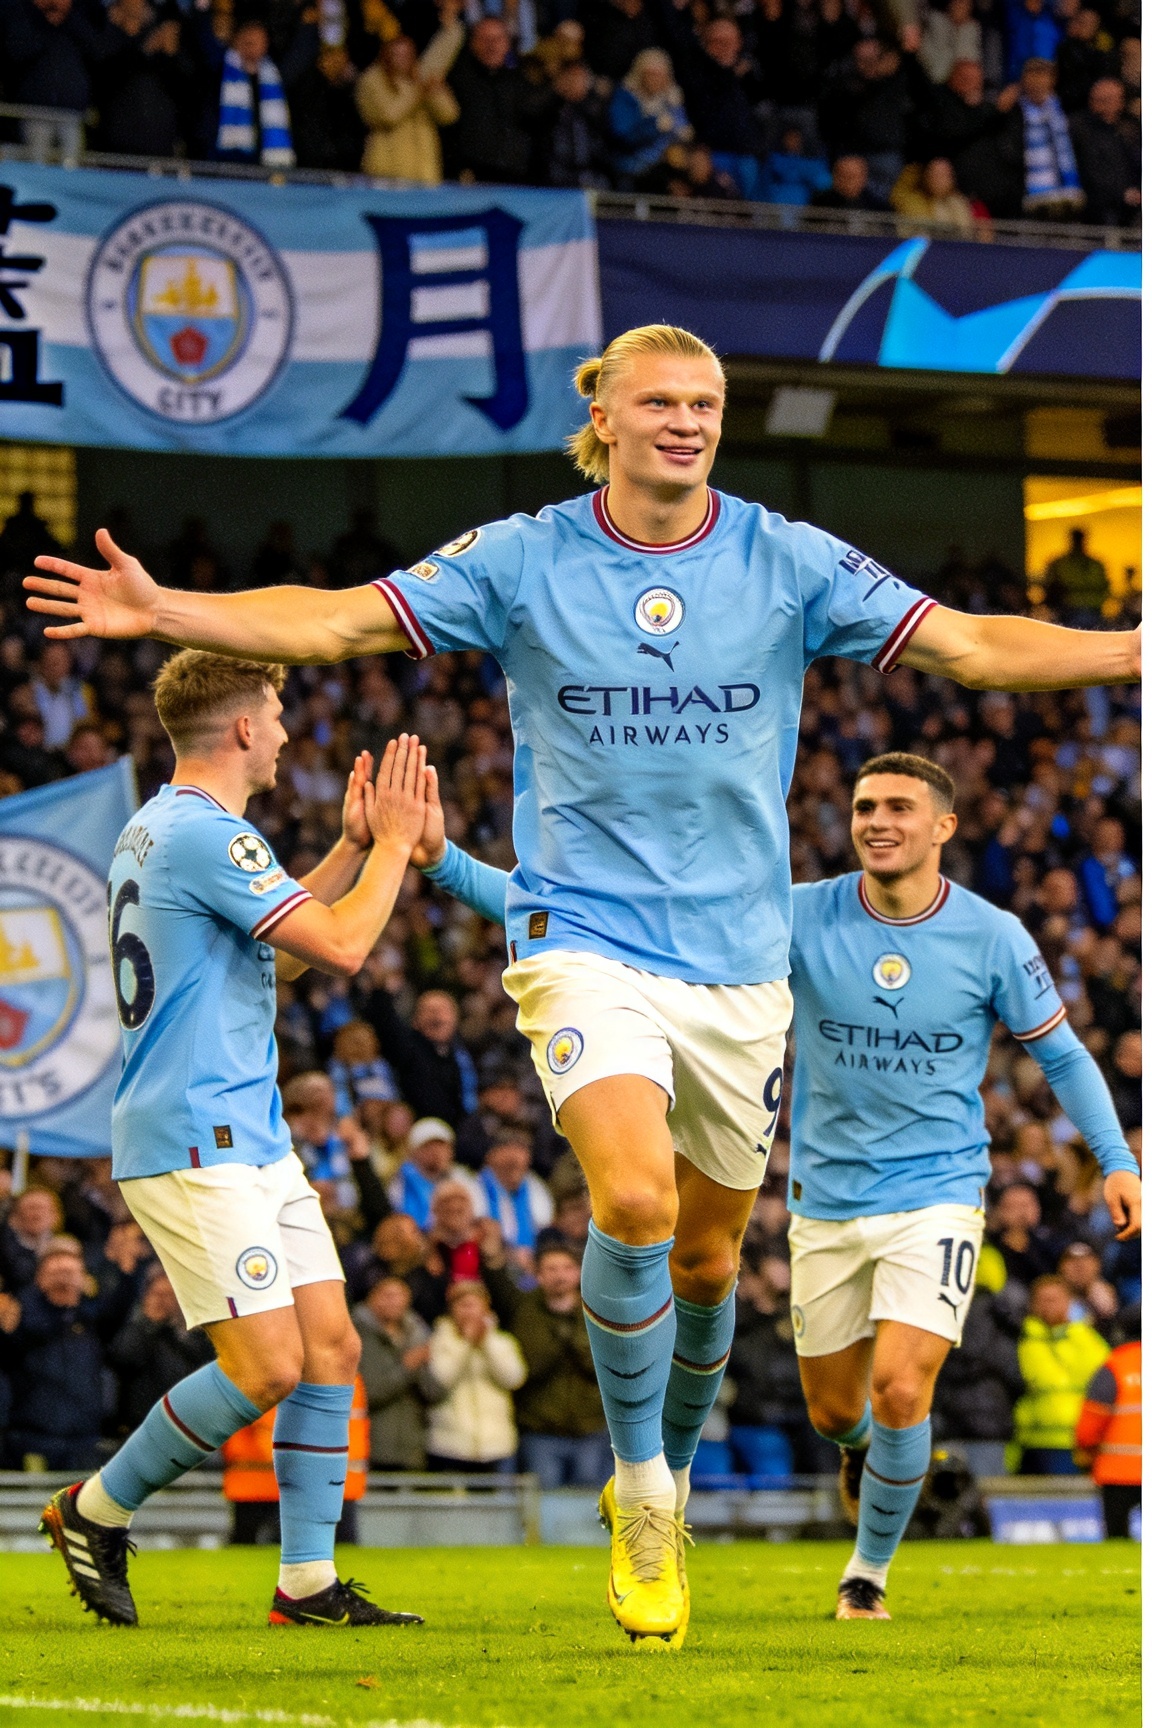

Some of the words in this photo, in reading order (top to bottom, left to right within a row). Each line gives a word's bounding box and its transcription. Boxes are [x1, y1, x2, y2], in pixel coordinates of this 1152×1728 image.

[557, 683, 761, 716] ETIHAD
[589, 723, 730, 746] AIRWAYS
[819, 1019, 963, 1053] ETIHAD
[834, 1051, 937, 1076] AIRWAYS
[763, 1067, 783, 1137] 9
[937, 1237, 976, 1295] 10
